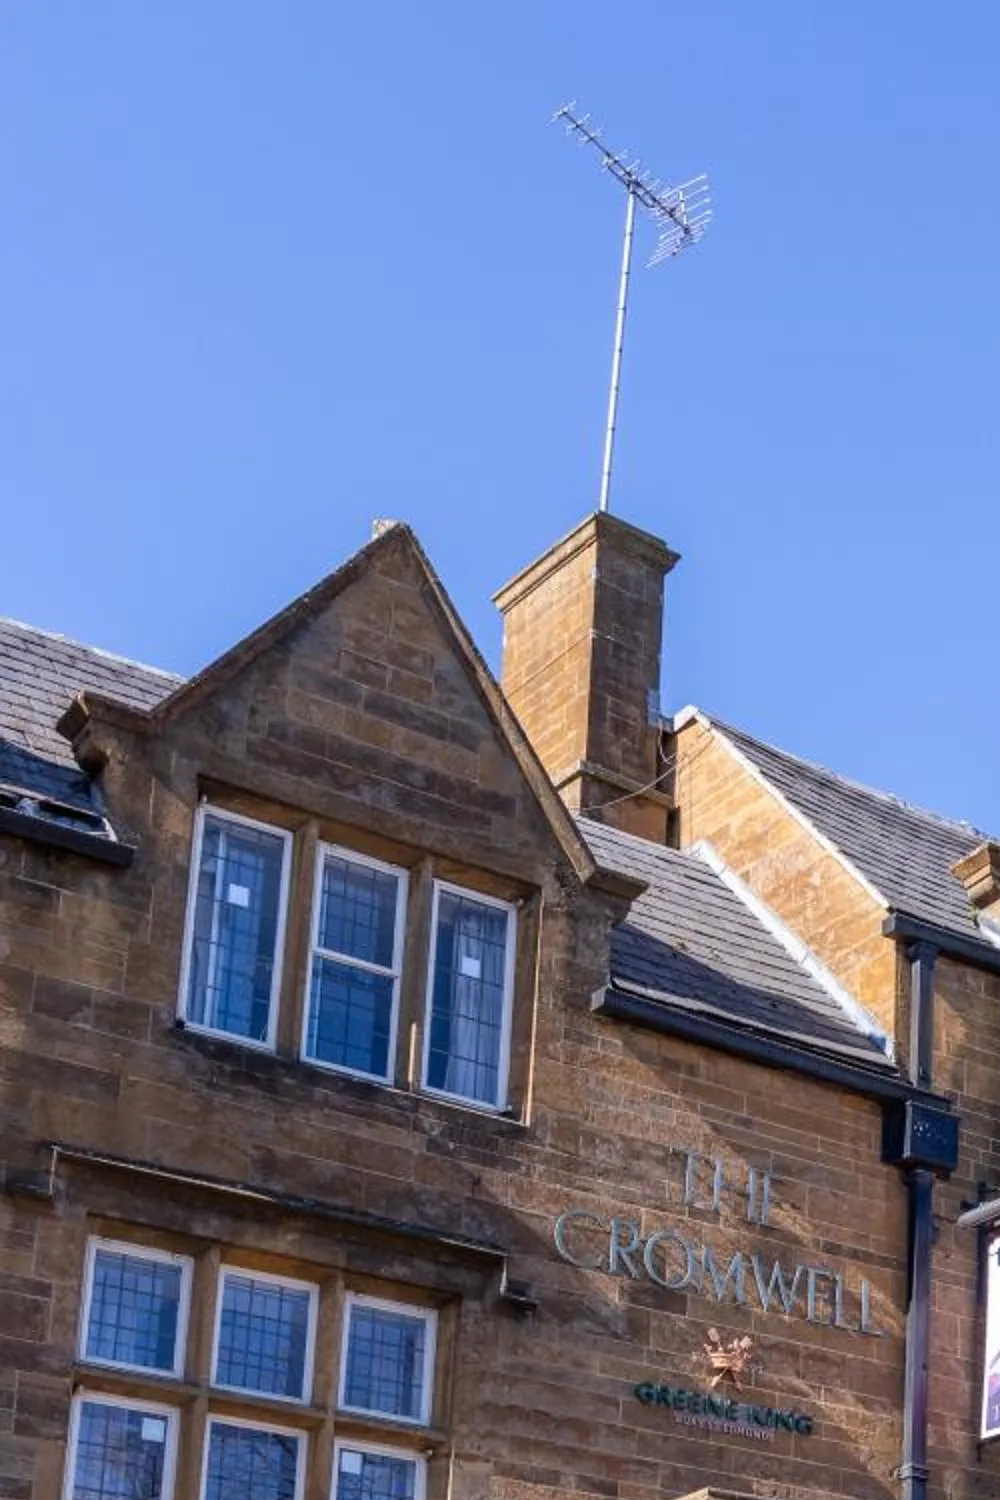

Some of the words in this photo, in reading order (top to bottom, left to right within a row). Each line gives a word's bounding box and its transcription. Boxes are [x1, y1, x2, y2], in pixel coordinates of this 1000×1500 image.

[669, 1147, 780, 1227] THE
[554, 1208, 888, 1337] CROMWELL
[633, 1381, 739, 1421] GREENE
[747, 1405, 813, 1435] KING
